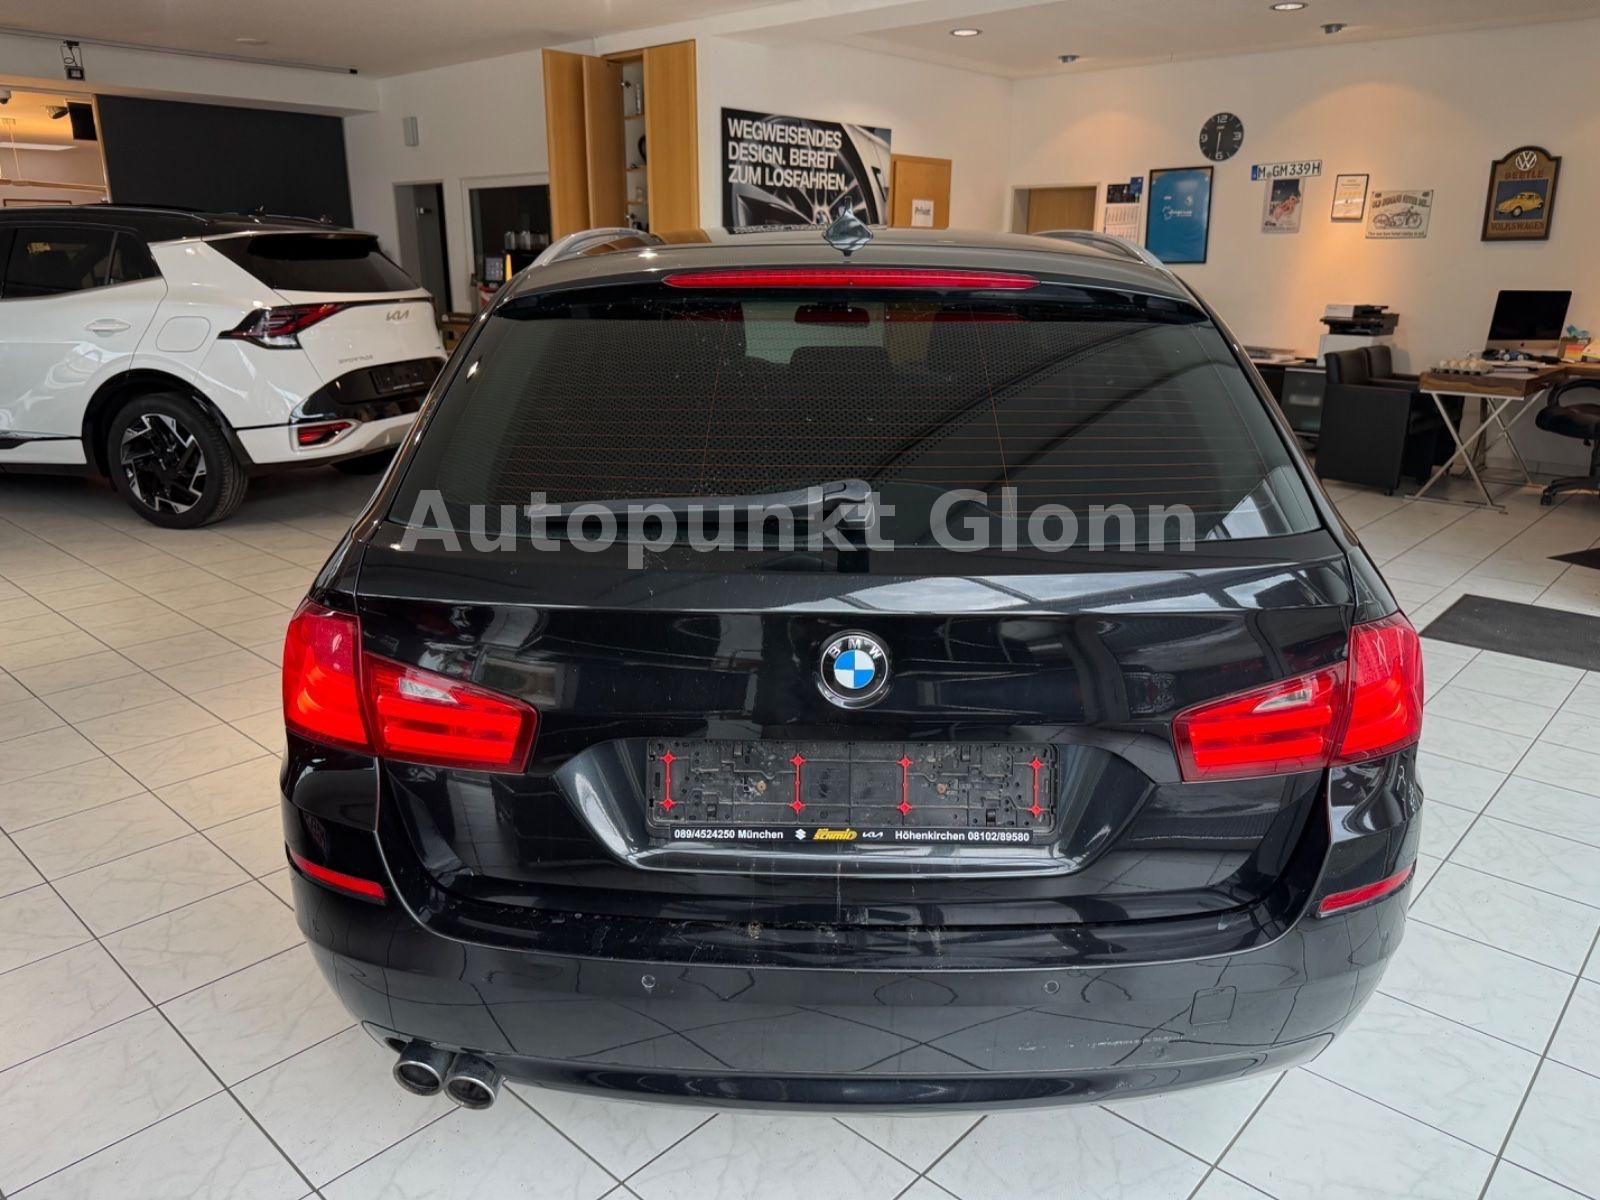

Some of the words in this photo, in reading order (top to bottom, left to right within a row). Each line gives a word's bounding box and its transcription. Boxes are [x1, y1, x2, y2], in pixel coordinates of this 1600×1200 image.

[1217, 115, 1228, 125] 12
[727, 117, 842, 149] WEGWEISENDES
[1200, 133, 1209, 143] 9
[1233, 131, 1242, 141] 3
[728, 141, 786, 165] DESIGN.
[789, 149, 838, 170] BEREIT
[728, 164, 762, 185] ZUM
[765, 168, 848, 191] LOSFAHREN.
[827, 637, 882, 660] BMW
[674, 828, 735, 840] 089/4524250
[737, 828, 784, 840] München
[894, 829, 965, 842] Höhenkirchen
[967, 831, 1030, 842] 08102/89580
